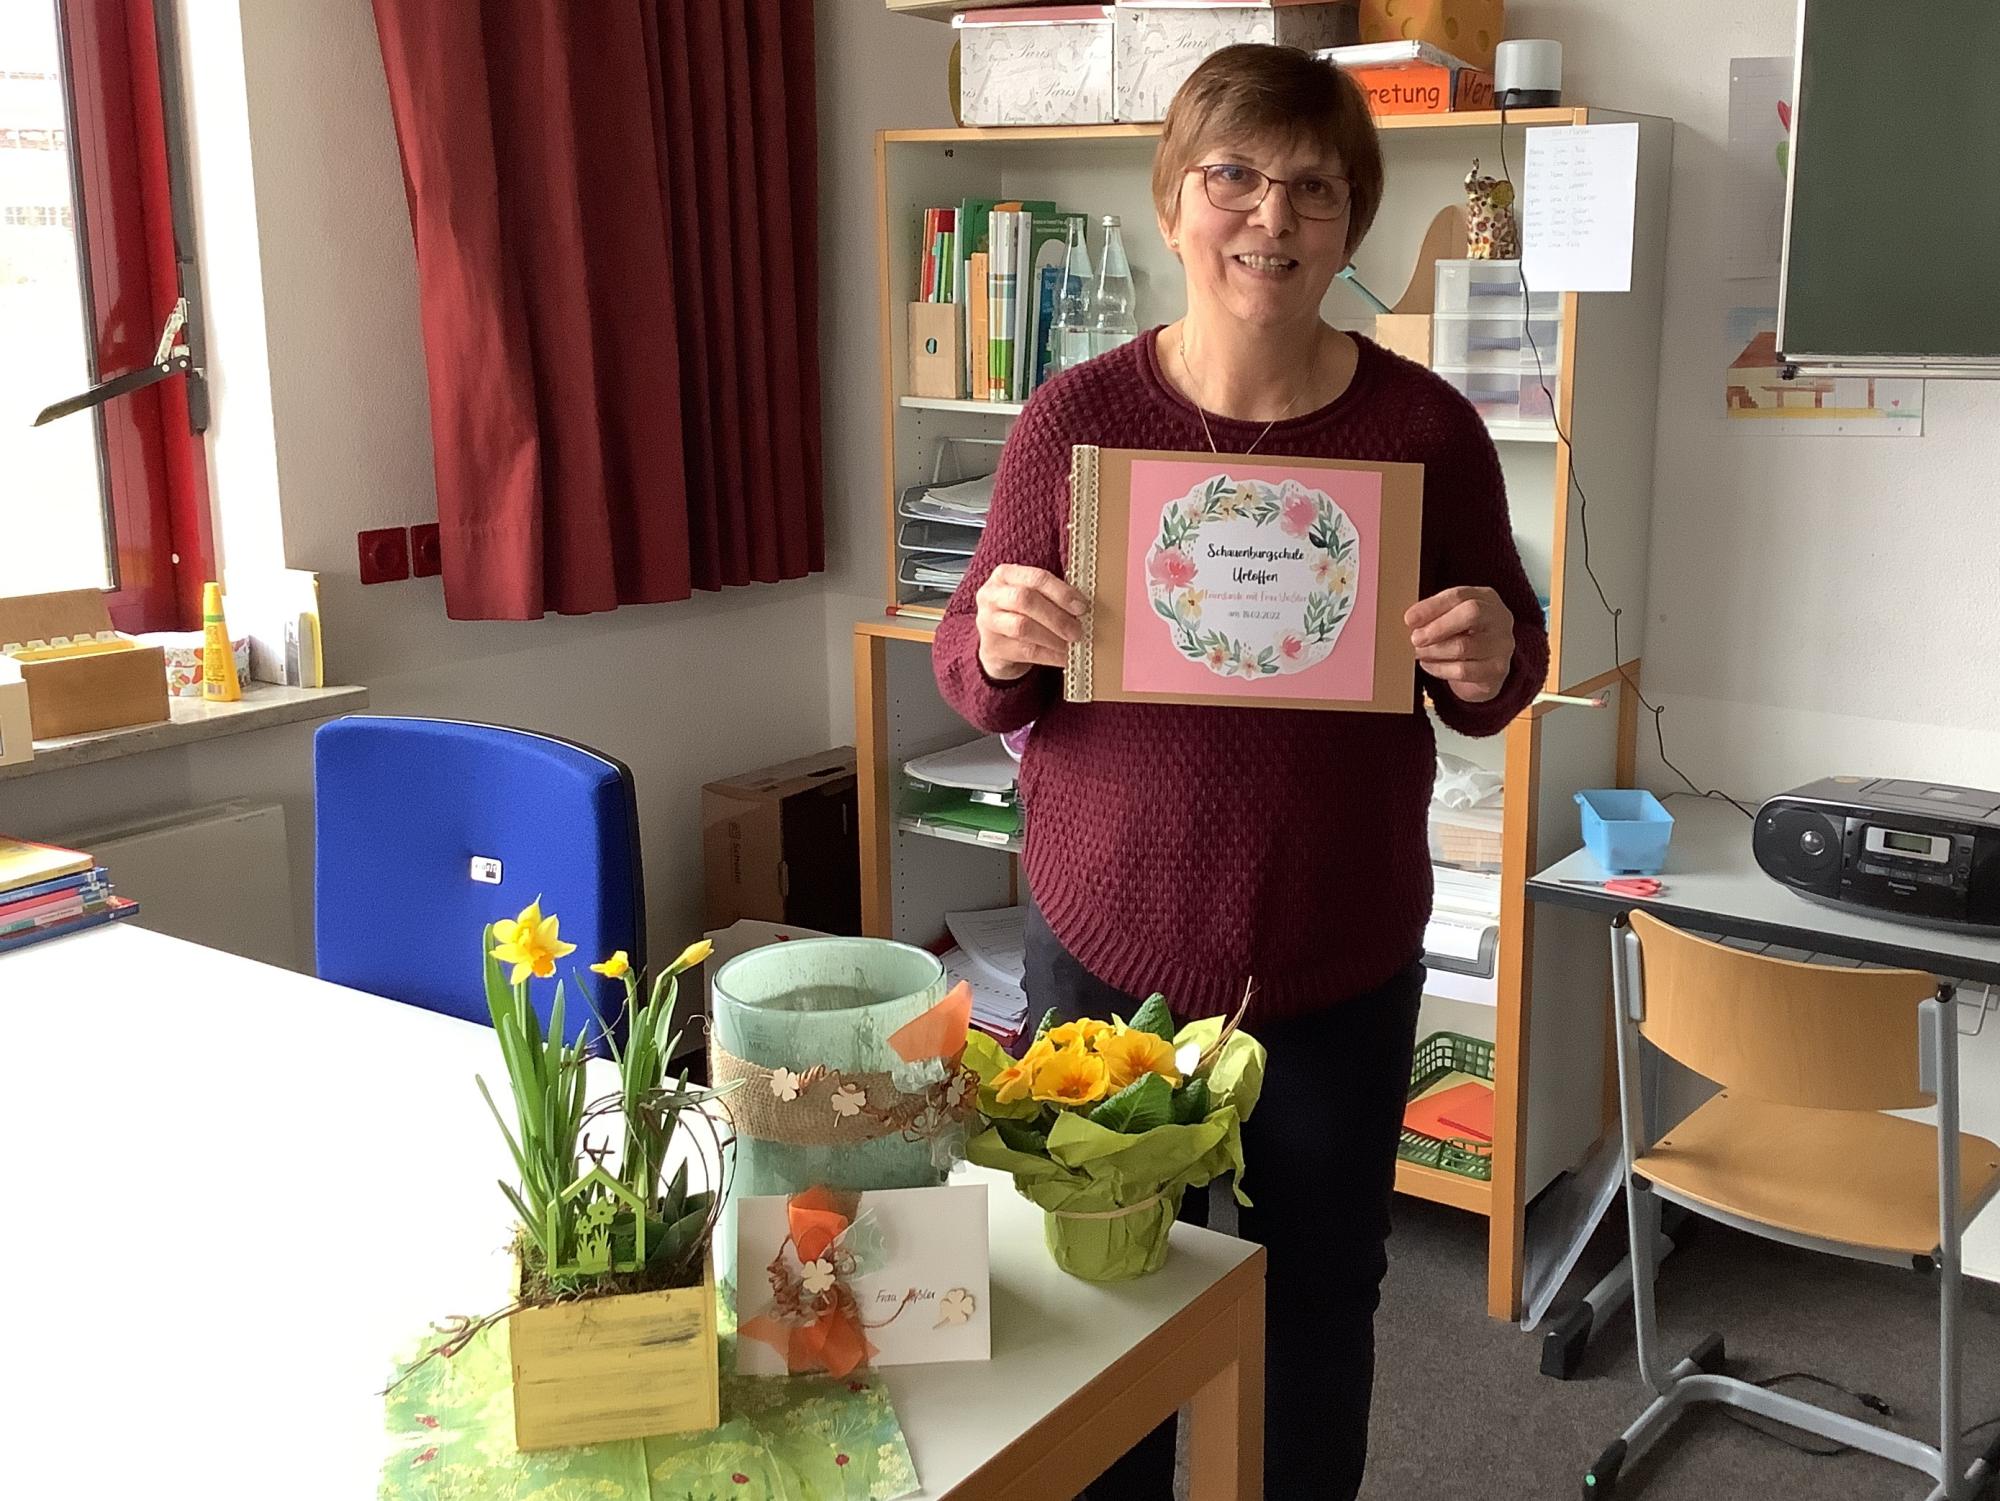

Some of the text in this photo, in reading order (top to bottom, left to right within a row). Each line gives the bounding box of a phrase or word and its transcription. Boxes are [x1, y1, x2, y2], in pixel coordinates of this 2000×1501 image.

[1010, 39, 1051, 58] Paris
[1165, 31, 1209, 49] Paris
[1036, 79, 1077, 97] Paris
[1369, 84, 1440, 109] retung
[1207, 543, 1304, 562] Schauenburgschule
[1233, 567, 1278, 585] Urloffen
[875, 1288, 897, 1304] Frau
